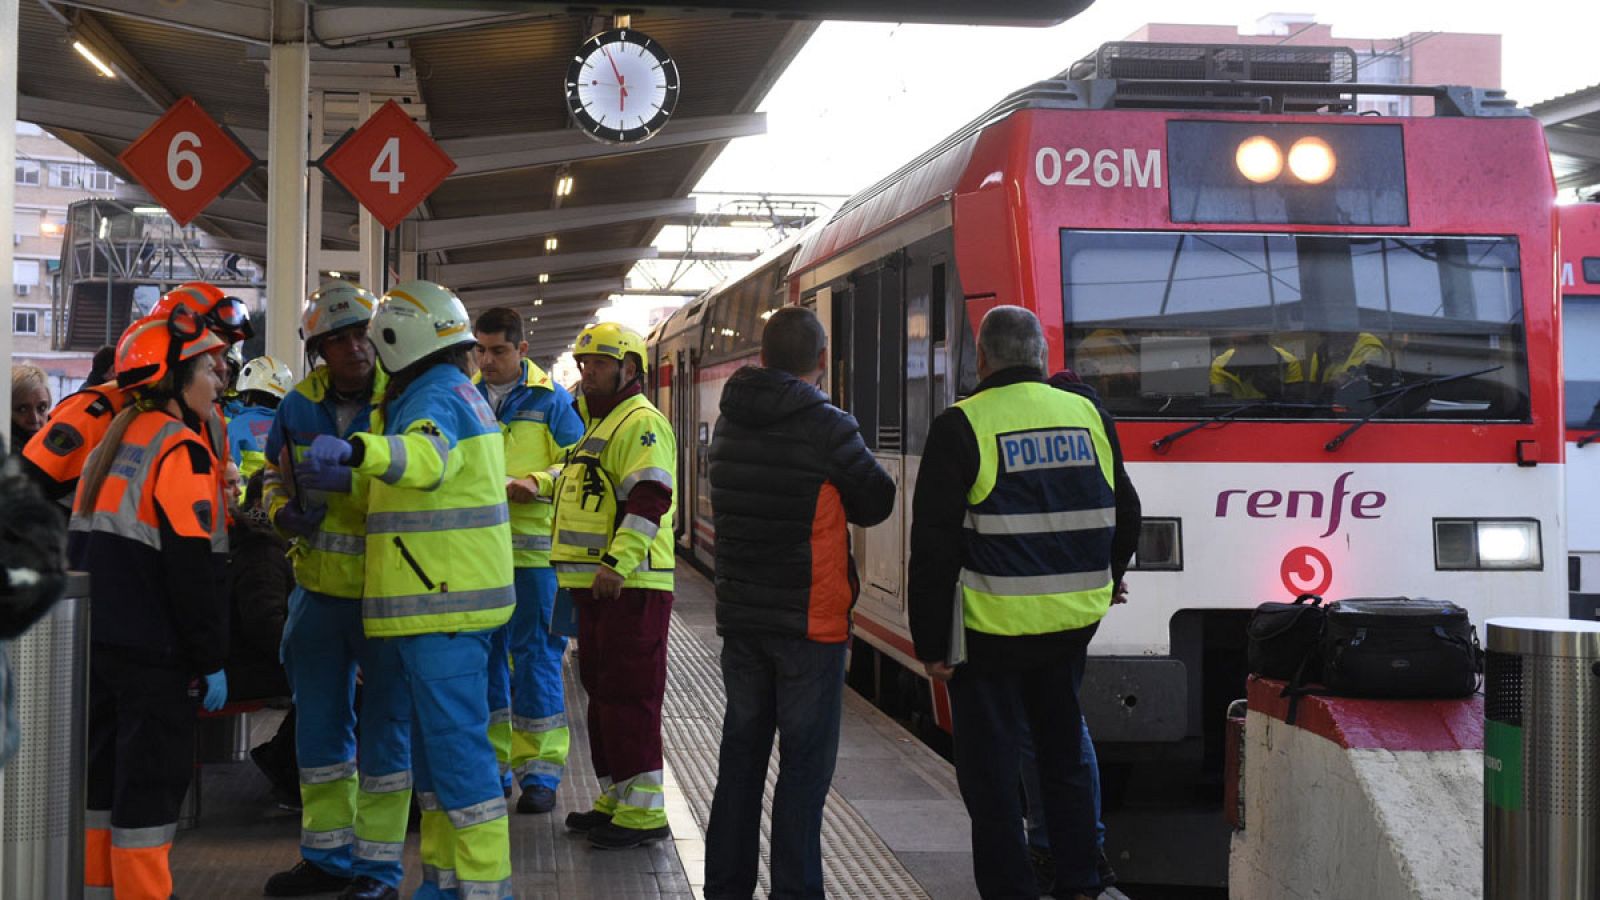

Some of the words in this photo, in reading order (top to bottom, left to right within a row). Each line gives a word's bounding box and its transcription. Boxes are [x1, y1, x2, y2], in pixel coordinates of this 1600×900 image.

[166, 131, 203, 192] 6
[369, 137, 405, 194] 4
[1035, 147, 1162, 189] 026M
[1215, 471, 1387, 538] renfe
